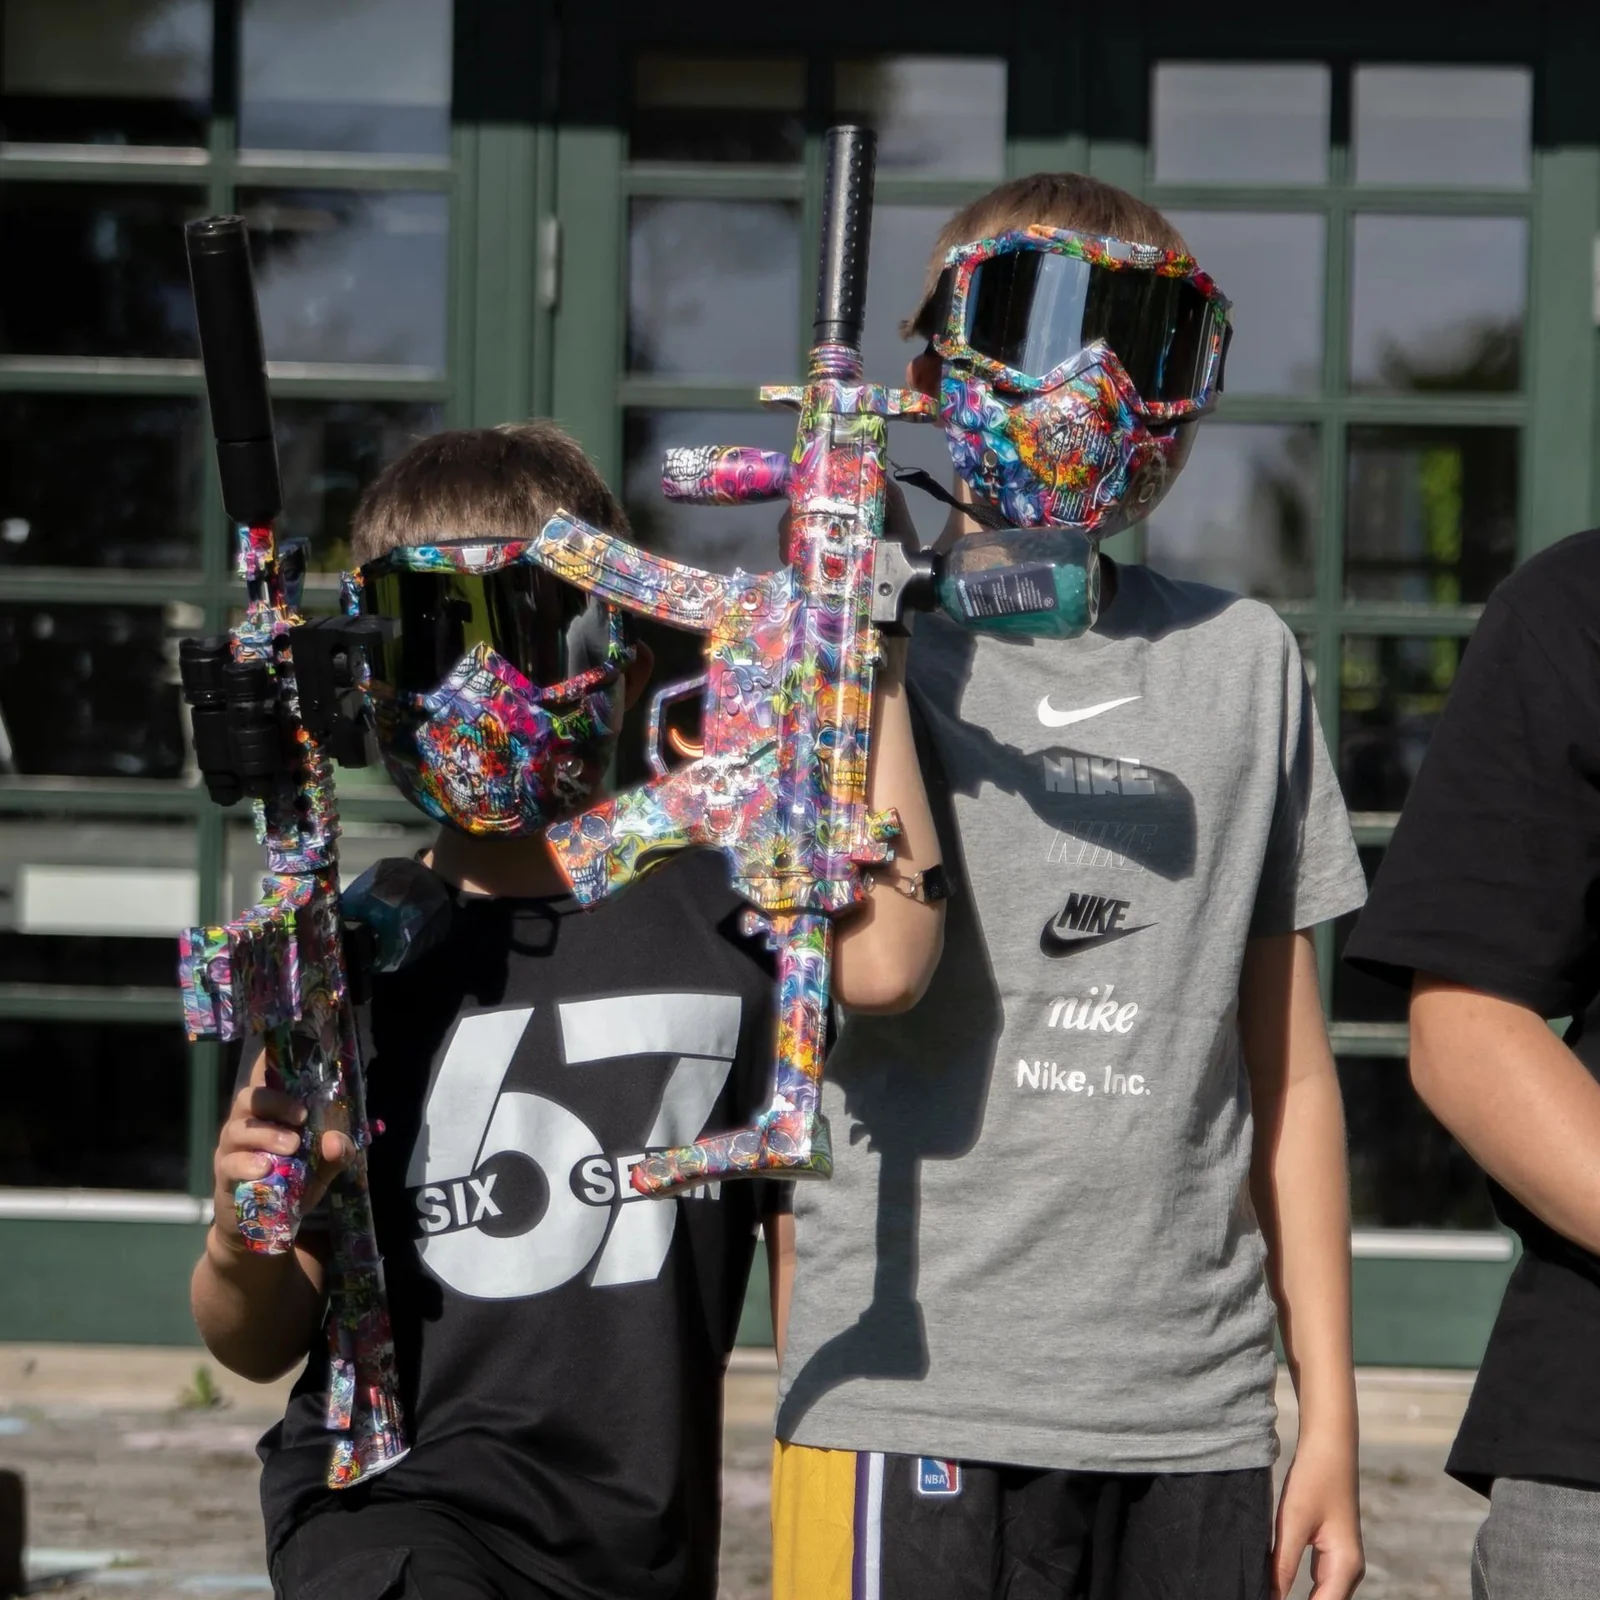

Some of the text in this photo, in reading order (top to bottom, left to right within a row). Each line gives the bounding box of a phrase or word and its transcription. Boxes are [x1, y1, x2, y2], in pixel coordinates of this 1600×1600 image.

[1042, 755, 1156, 795] NIKE
[1047, 820, 1158, 872] NIKE
[1056, 892, 1131, 934] NIKE
[1047, 984, 1139, 1034] nike
[1016, 1058, 1151, 1097] Nike, Inc.
[414, 1173, 503, 1234] SIX
[924, 1473, 946, 1485] NBA
